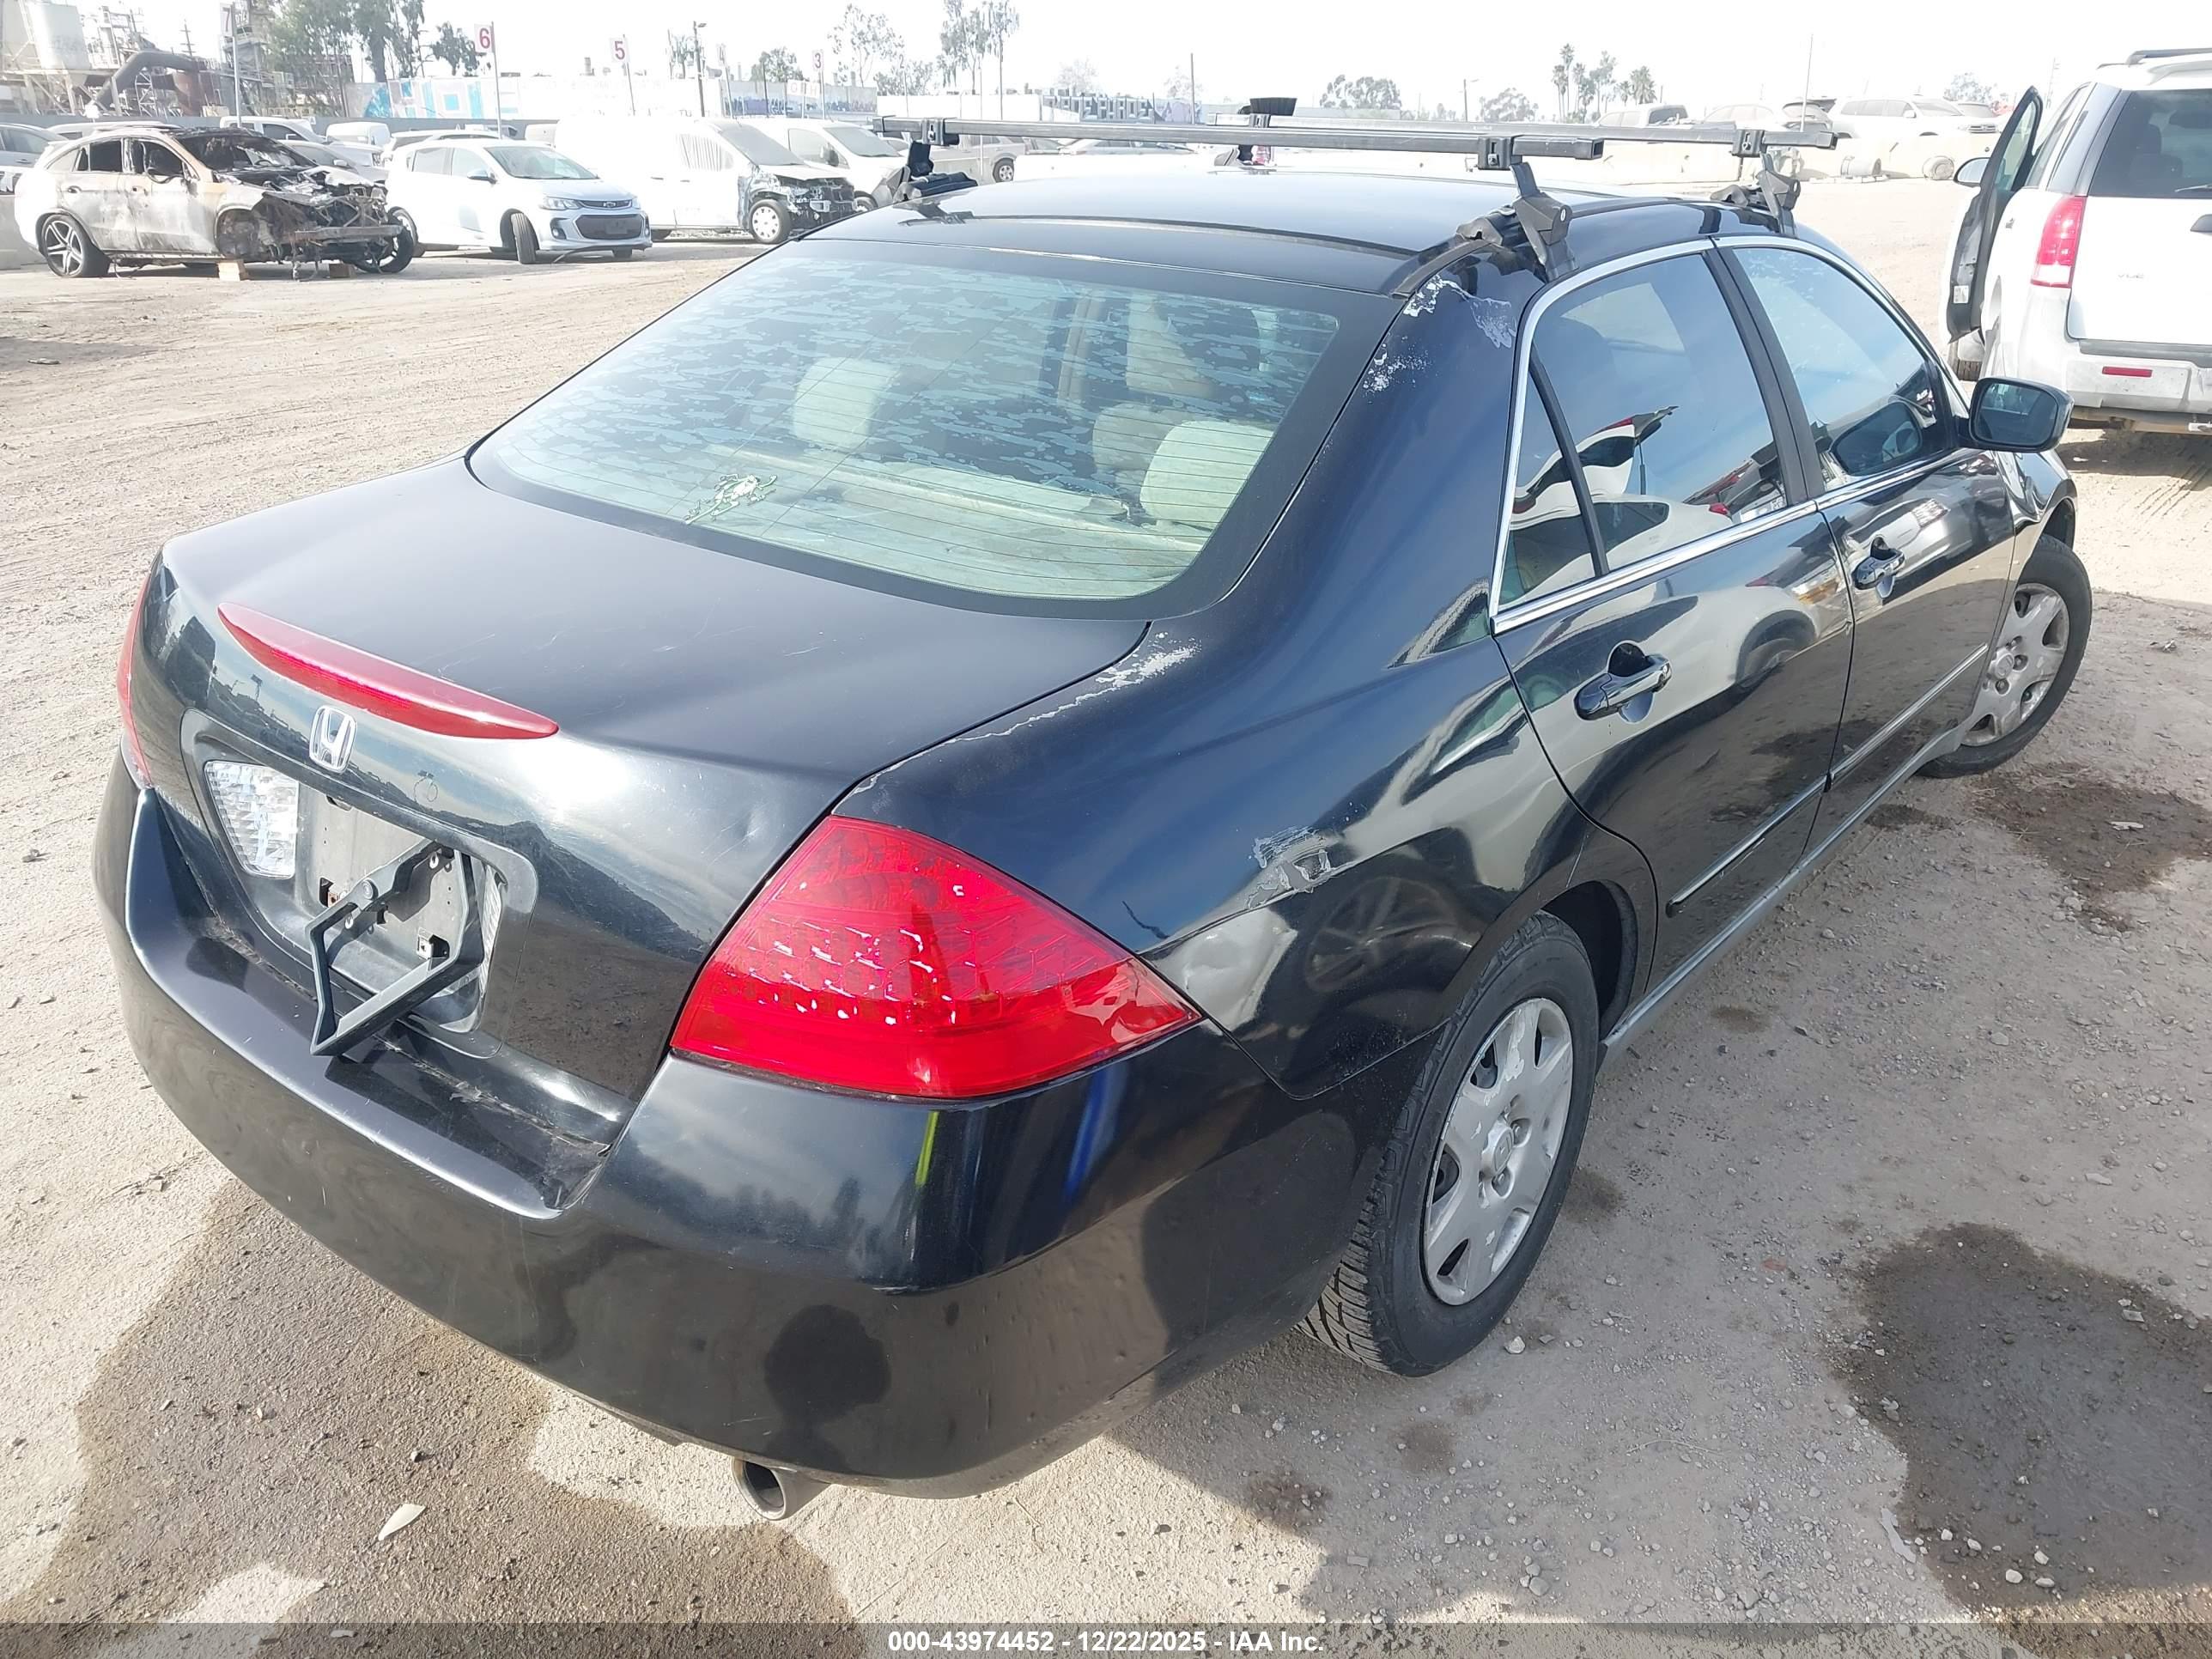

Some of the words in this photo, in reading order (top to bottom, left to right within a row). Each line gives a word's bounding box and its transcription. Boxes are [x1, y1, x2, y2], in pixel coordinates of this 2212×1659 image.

[222, 7, 231, 33] 7
[479, 27, 490, 49] 6
[613, 40, 626, 60] 5
[814, 52, 822, 69] 3
